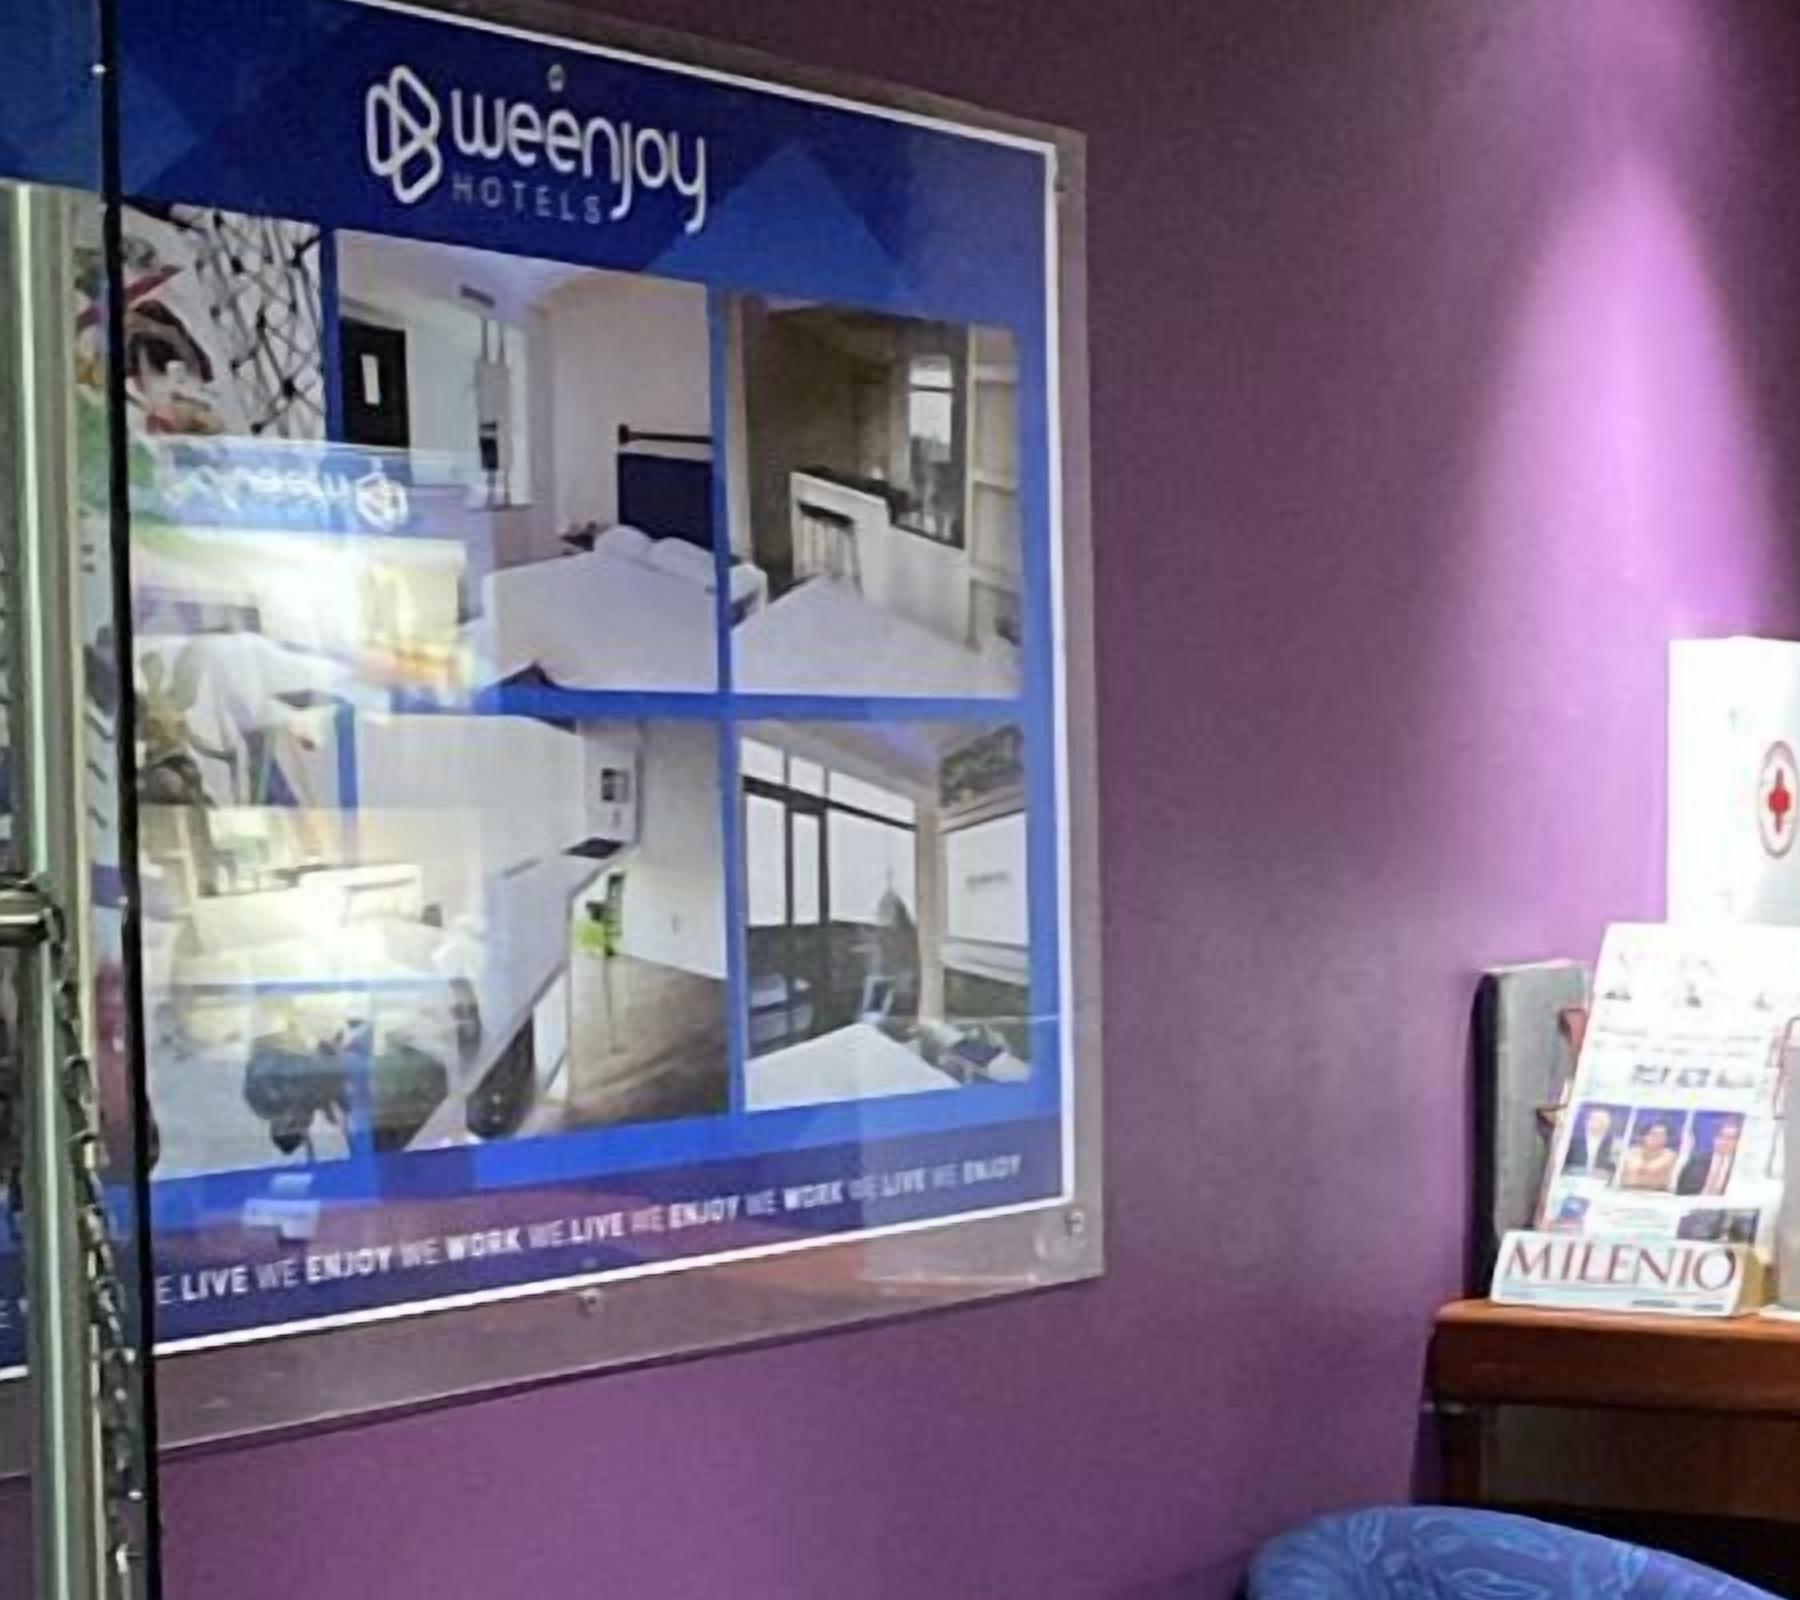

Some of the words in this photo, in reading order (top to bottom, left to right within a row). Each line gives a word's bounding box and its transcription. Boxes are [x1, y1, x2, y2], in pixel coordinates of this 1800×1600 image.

[451, 88, 706, 235] weenjoy
[452, 172, 601, 224] HOTELS
[181, 1265, 249, 1301] LIVE
[255, 1258, 299, 1291] WE
[305, 1245, 392, 1283] ENJOY
[400, 1238, 440, 1268] WE
[446, 1226, 523, 1261] WORK
[528, 1220, 566, 1250] WE
[570, 1211, 627, 1245] LIVE
[631, 1204, 668, 1234] WE
[669, 1196, 741, 1230] ENJOY
[745, 1190, 777, 1218] WE
[783, 1180, 843, 1210] WORK
[882, 1166, 926, 1197] LIVE
[962, 1153, 1024, 1186] ENJOY
[1503, 1239, 1738, 1292] MILENIO
